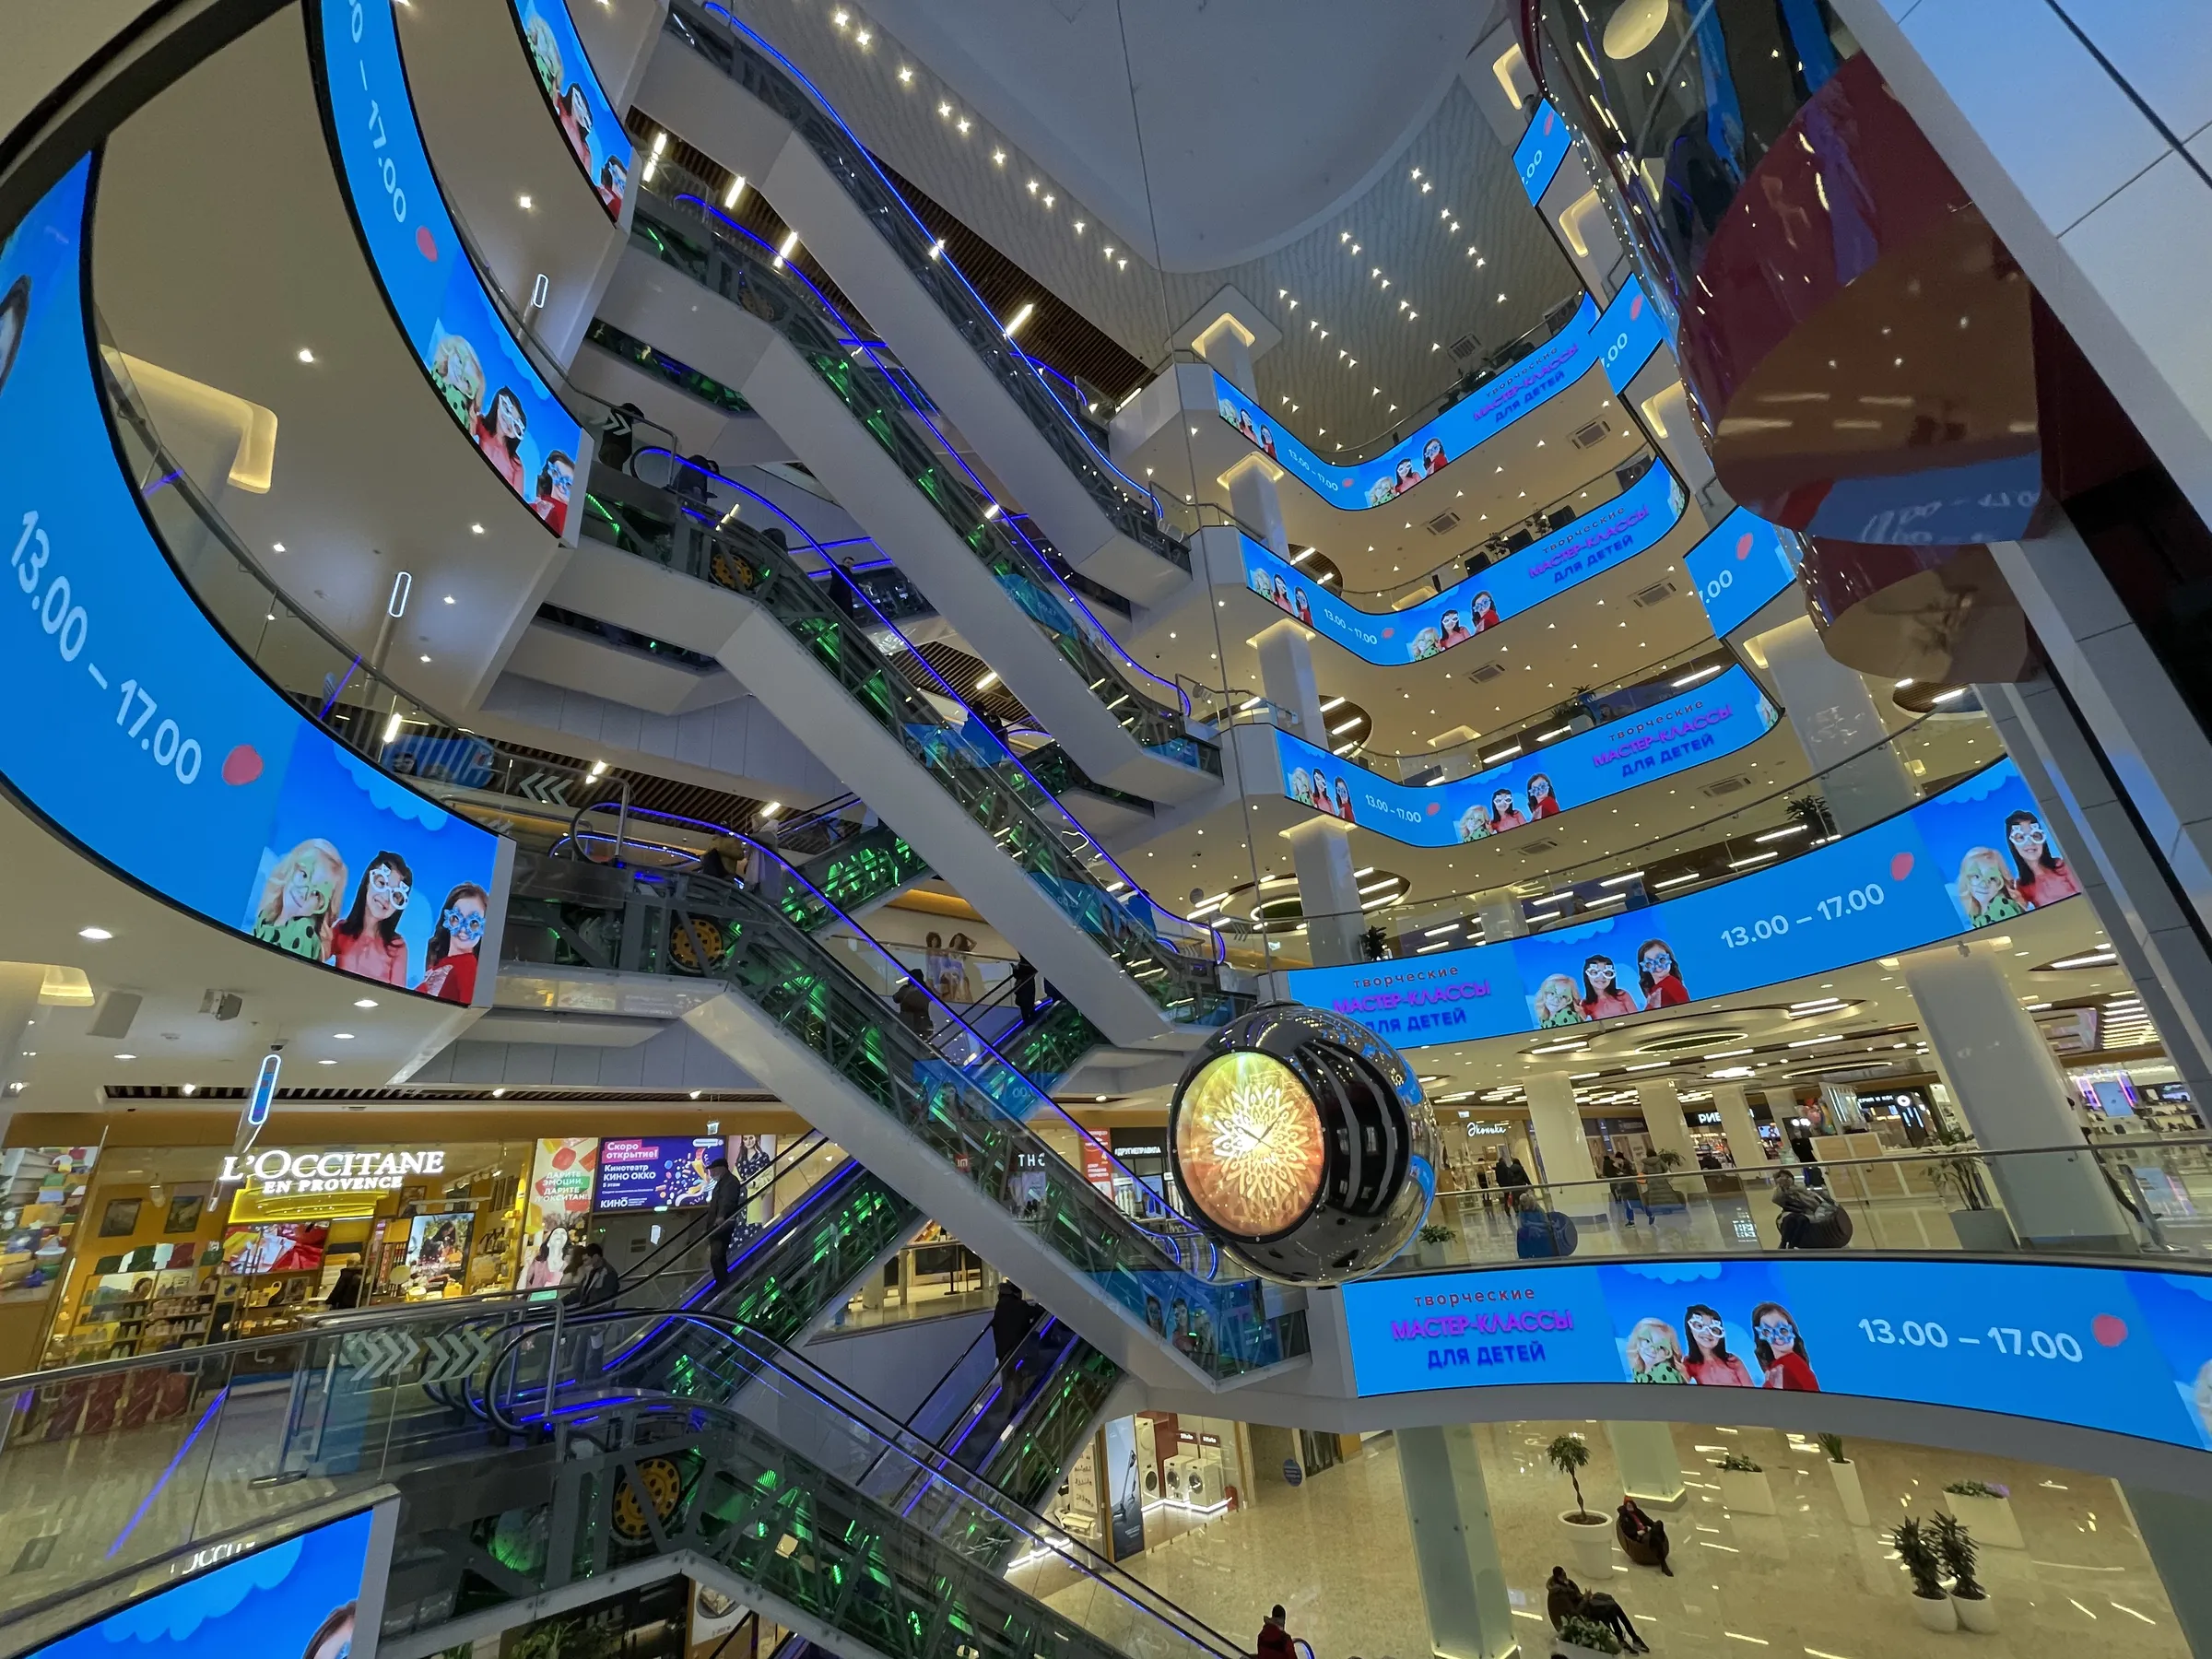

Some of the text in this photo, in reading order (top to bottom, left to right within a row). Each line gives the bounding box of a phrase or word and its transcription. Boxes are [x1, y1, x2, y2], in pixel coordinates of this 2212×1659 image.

[369, 100, 406, 223] 17.00
[1495, 370, 1565, 423] ДЛЯ ДЕТЕЙ
[1528, 503, 1650, 579] МАСТЕР-КЛАССЫ
[1543, 507, 1625, 554] творческие
[1554, 534, 1634, 583] ДЛЯ ДЕТЕЙ
[1324, 608, 1346, 629] 13.00
[1354, 628, 1377, 644] 17.00
[11, 510, 88, 662] 13.00
[116, 678, 202, 784] 17.00
[1593, 703, 1734, 768] МАСТЕР-КЛАССЫ
[1608, 700, 1703, 742] творческие
[1622, 733, 1715, 778] ДЛЯ ДЕТЕЙ
[1365, 794, 1388, 812] 13.00
[1396, 807, 1421, 823] 17.00
[1720, 914, 1789, 948] 13.00
[1817, 883, 1885, 921] 17.00
[1353, 967, 1459, 988] творческие
[1333, 979, 1491, 1014] МАСТЕР-КЛАССЫ
[1406, 1007, 1467, 1032] ДЕТЕЙ
[606, 1148, 658, 1160] открытие!
[607, 1142, 639, 1154] Скоро
[219, 1149, 445, 1182] L'OCCITANE
[546, 1171, 582, 1180] ДАРИТЕ
[604, 1164, 649, 1172] Кинотеатр
[604, 1171, 657, 1181] КИНО ОККО
[263, 1175, 404, 1194] EN PROVENCE
[542, 1178, 584, 1187] ЭМОЦИИ,
[544, 1186, 581, 1195] ДАРИТЕ
[600, 1199, 629, 1208] КИНО
[1414, 1288, 1535, 1308] творческие
[1391, 1309, 1574, 1341] МАСТЕР-КЛАССЫ
[1858, 1318, 1949, 1348] 13.00
[1987, 1326, 2084, 1363] 17.00
[1428, 1339, 1547, 1371] ДЛЯ ДЕТЕЙ
